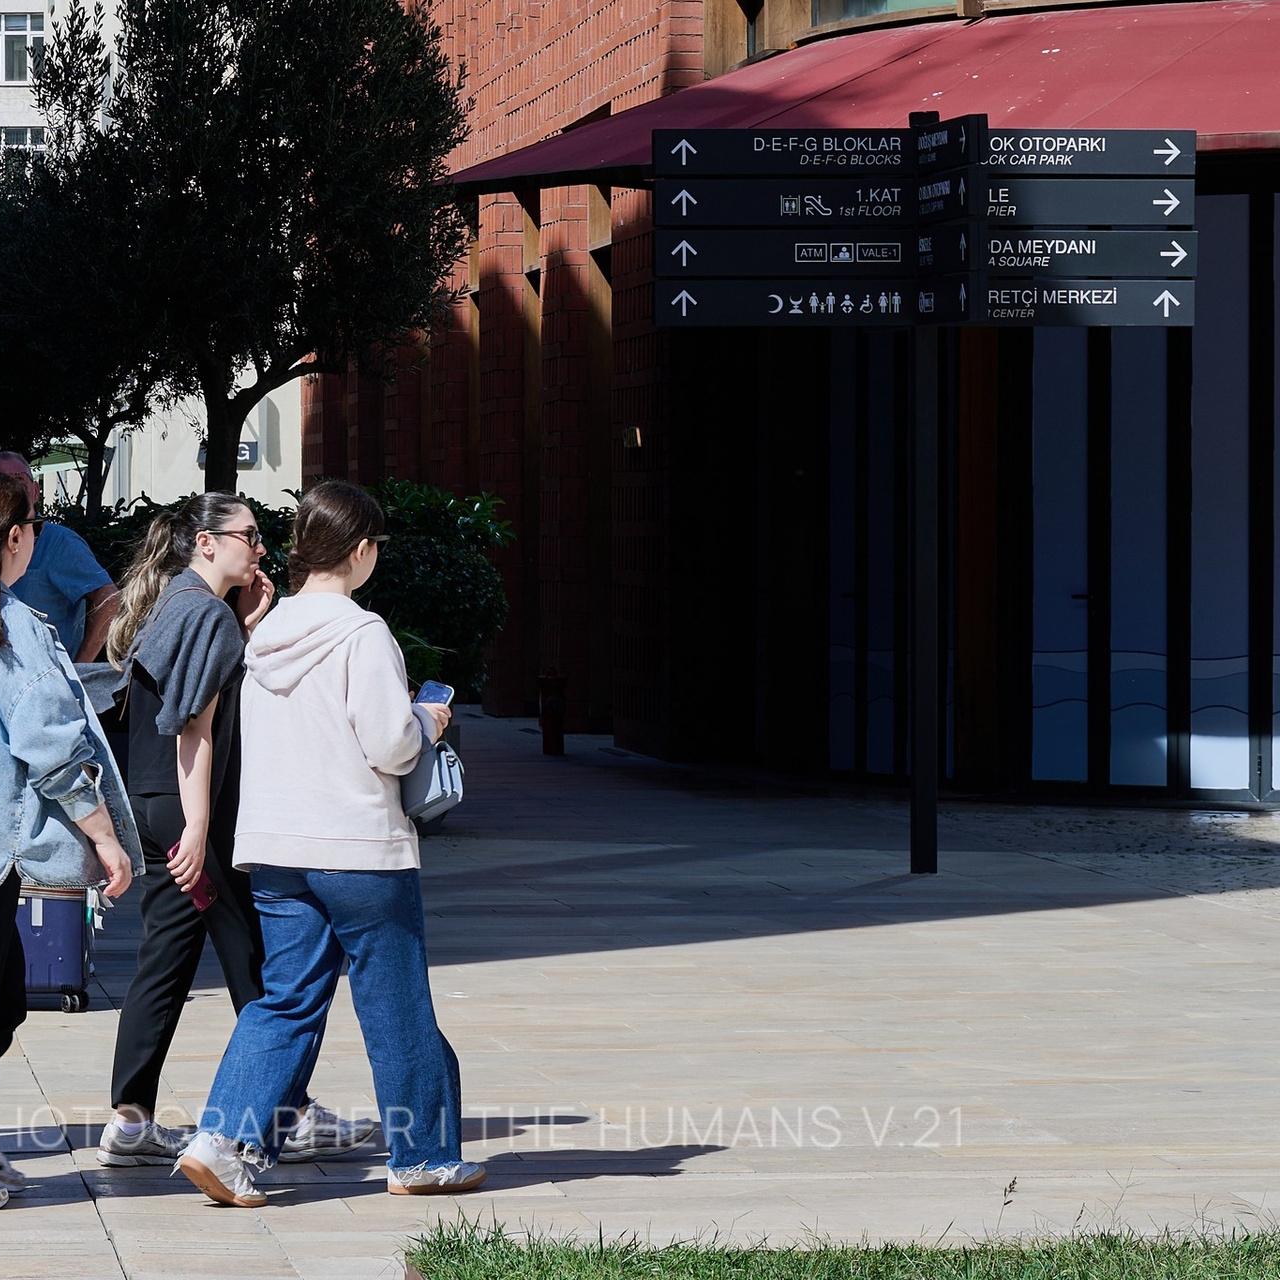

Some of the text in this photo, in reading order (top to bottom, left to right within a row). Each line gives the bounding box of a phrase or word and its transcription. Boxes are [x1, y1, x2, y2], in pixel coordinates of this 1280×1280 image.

[753, 137, 902, 152] D-E-F-G BLOKLAR
[987, 137, 1106, 152] OK OTOPARKI
[799, 154, 902, 165] D-E-F-G BLOCKS
[1009, 154, 1037, 165] CAR
[1039, 154, 1074, 165] PARK
[856, 188, 902, 202] 1.KAT
[839, 206, 902, 216] 1st FLOOR
[987, 205, 1017, 216] PIER
[988, 240, 1096, 254] DA MEYDANI
[800, 248, 823, 258] ATM
[861, 248, 897, 258] VALE-1
[998, 256, 1051, 267] SQUARE
[1043, 287, 1117, 304] MERKEZİ
[992, 308, 1035, 318] CENTER
